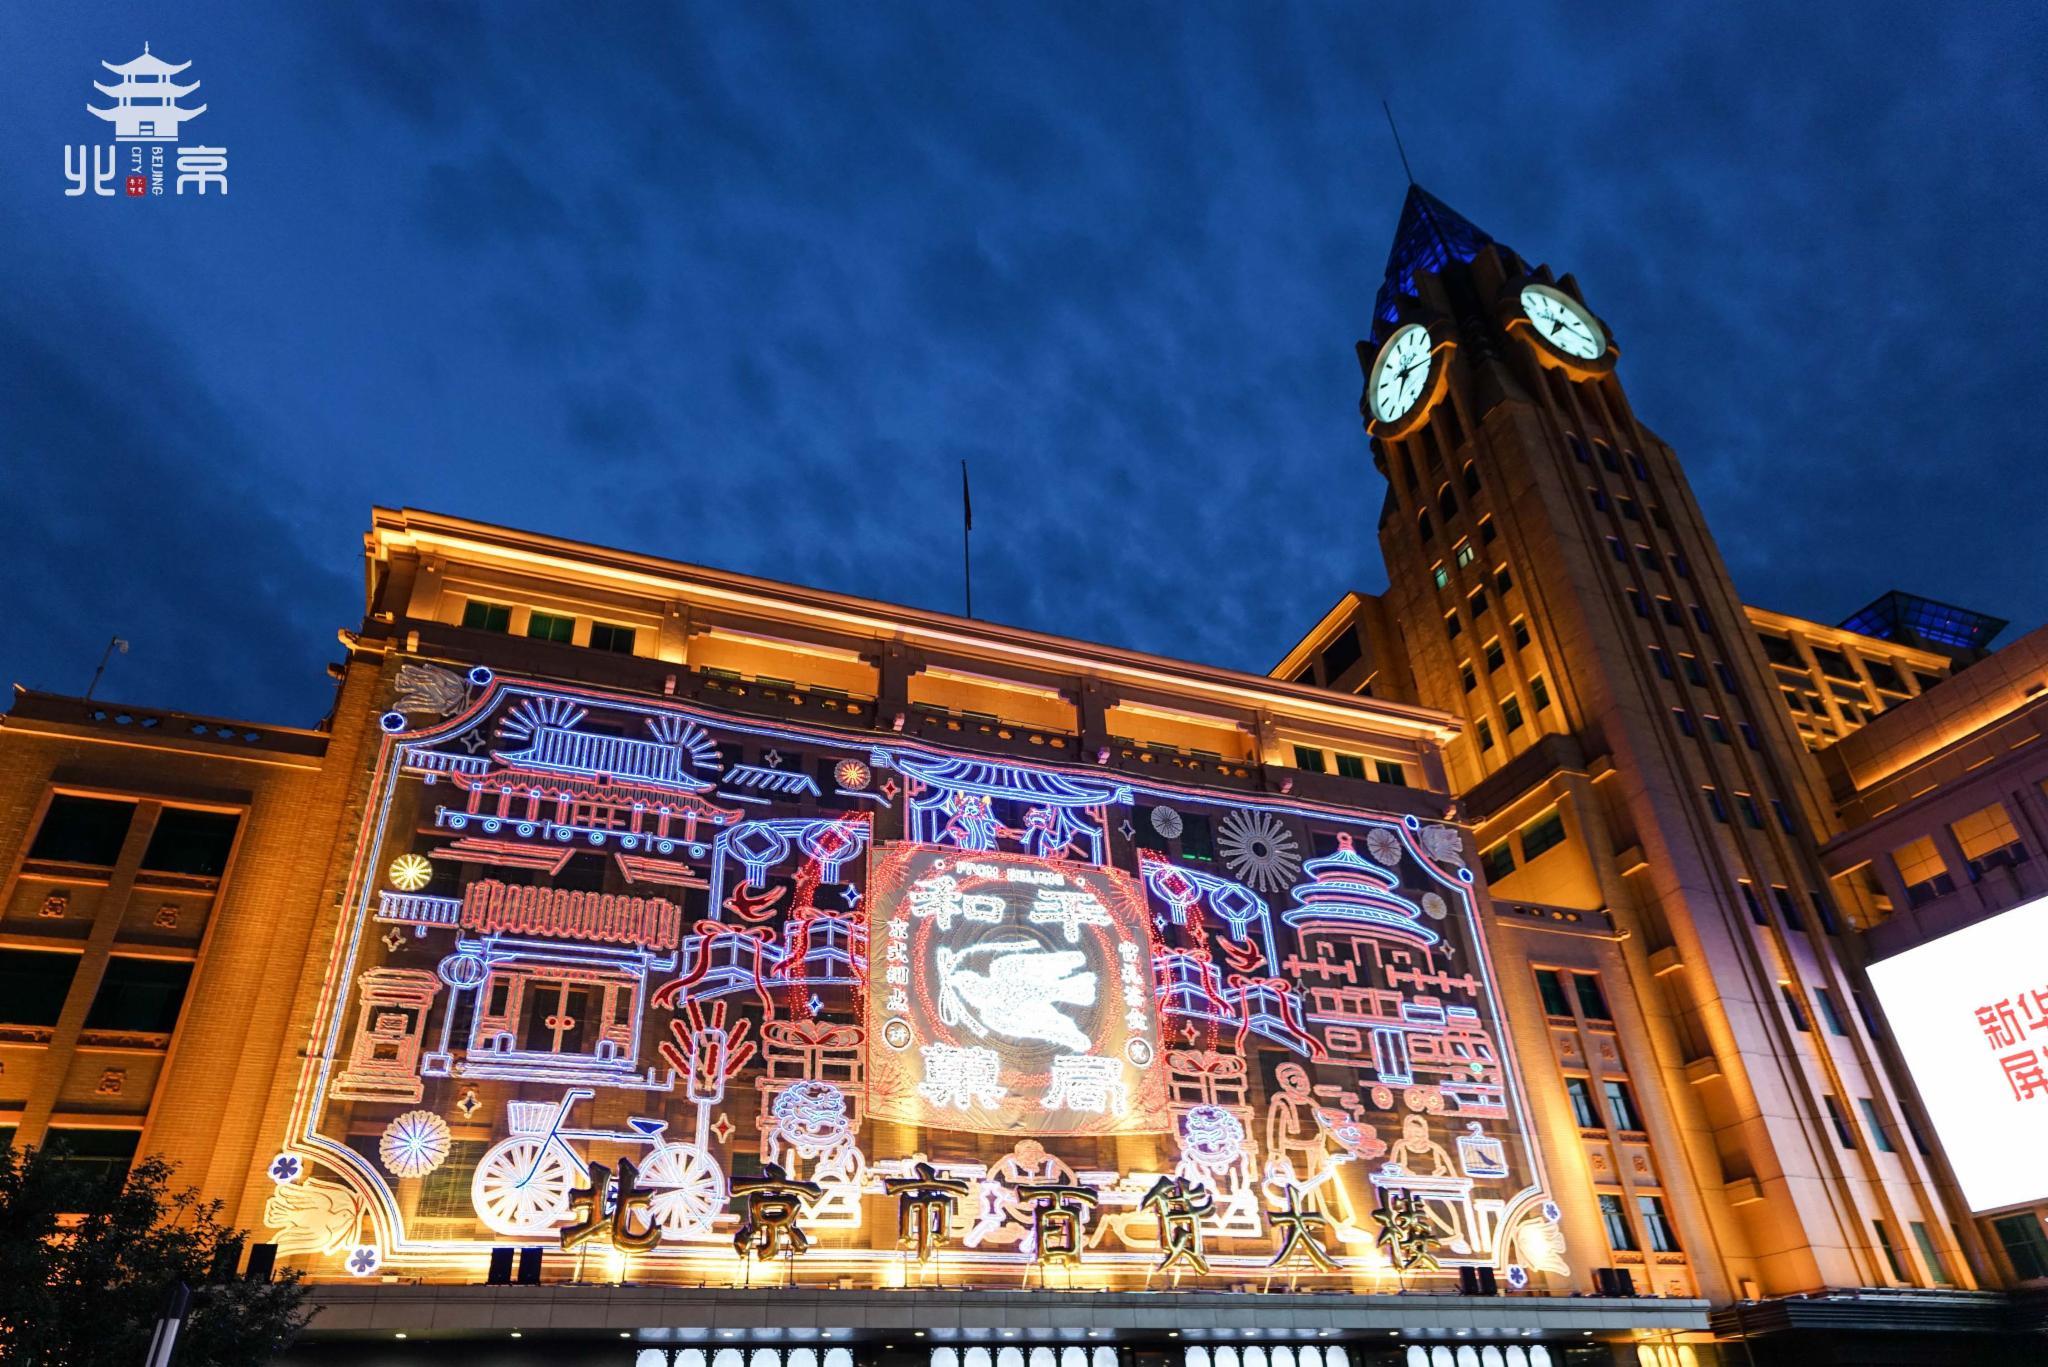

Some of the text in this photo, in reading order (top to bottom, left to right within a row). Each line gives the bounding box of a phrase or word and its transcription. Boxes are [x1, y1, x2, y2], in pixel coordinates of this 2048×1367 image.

[955, 861, 1065, 886] FROM BEIJING
[909, 875, 1113, 943] 和平
[1999, 1046, 2048, 1102] 屏
[559, 1157, 1441, 1276] 北京市百货大楼
